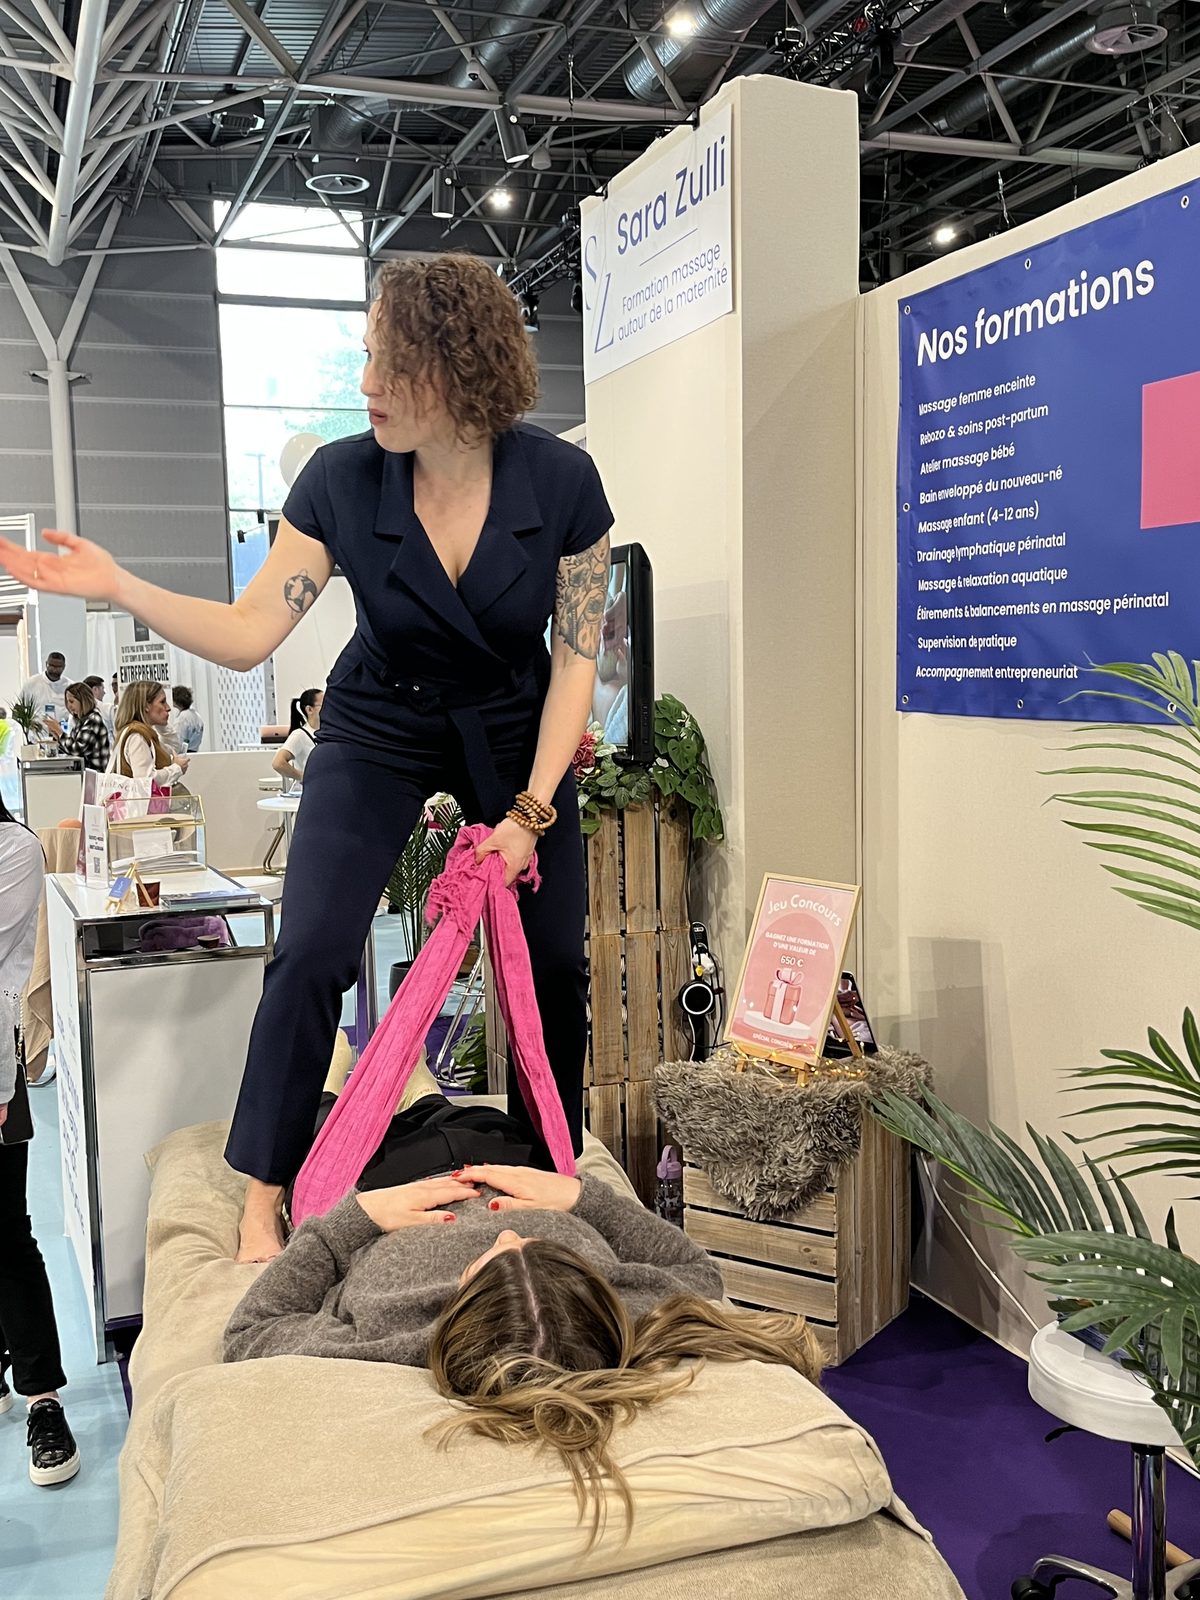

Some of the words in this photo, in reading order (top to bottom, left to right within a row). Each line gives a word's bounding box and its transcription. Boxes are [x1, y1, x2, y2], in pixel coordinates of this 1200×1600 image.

[617, 191, 667, 256] Sara
[675, 135, 726, 218] Zulli
[622, 275, 669, 315] Formation
[671, 243, 721, 286] massage
[618, 312, 647, 341] autour
[650, 303, 662, 324] de
[664, 296, 674, 316] la
[676, 262, 728, 310] maternité
[916, 325, 968, 367] Nos
[974, 260, 1155, 349] formations
[918, 397, 957, 416] Massage
[959, 387, 993, 405] femme
[994, 374, 1036, 396] enceinte
[920, 429, 945, 446] Rebozo
[947, 426, 956, 438] &
[958, 421, 984, 436] soins
[985, 404, 1049, 434] post-partum
[920, 459, 941, 475] Atelier
[942, 451, 989, 469] massage
[991, 442, 1015, 460] bébé
[919, 490, 937, 504] Bain
[938, 480, 982, 500] enveloppé
[985, 479, 998, 492] du
[1000, 465, 1063, 490] nouveau-né
[918, 516, 952, 533] Massage
[954, 511, 985, 527] enfant
[987, 507, 1013, 526] (4-12
[1015, 500, 1039, 520] ans)
[917, 548, 955, 563] Drainage
[955, 540, 1016, 562] lymphatique
[1017, 532, 1066, 555] périnatal
[918, 578, 956, 593] Massage
[957, 575, 963, 587] &
[963, 571, 1009, 586] relaxation
[1011, 567, 1068, 587] aquatique
[917, 605, 963, 621] Étirements
[964, 606, 970, 618] &
[970, 601, 1040, 618] balancements
[1042, 602, 1057, 613] en
[1059, 598, 1111, 615] massage
[1113, 592, 1169, 614] périnatal
[917, 636, 967, 652] Supervision
[968, 636, 978, 648] de
[978, 634, 1017, 651] pratique
[120, 663, 169, 683] ENTREPRENEURE
[915, 665, 994, 682] Accompagnement
[994, 664, 1078, 682] entrepreneuriat
[767, 899, 788, 915] Jeu
[790, 894, 843, 927] Concours
[797, 937, 830, 950] FORMATION
[780, 955, 796, 966] 650
